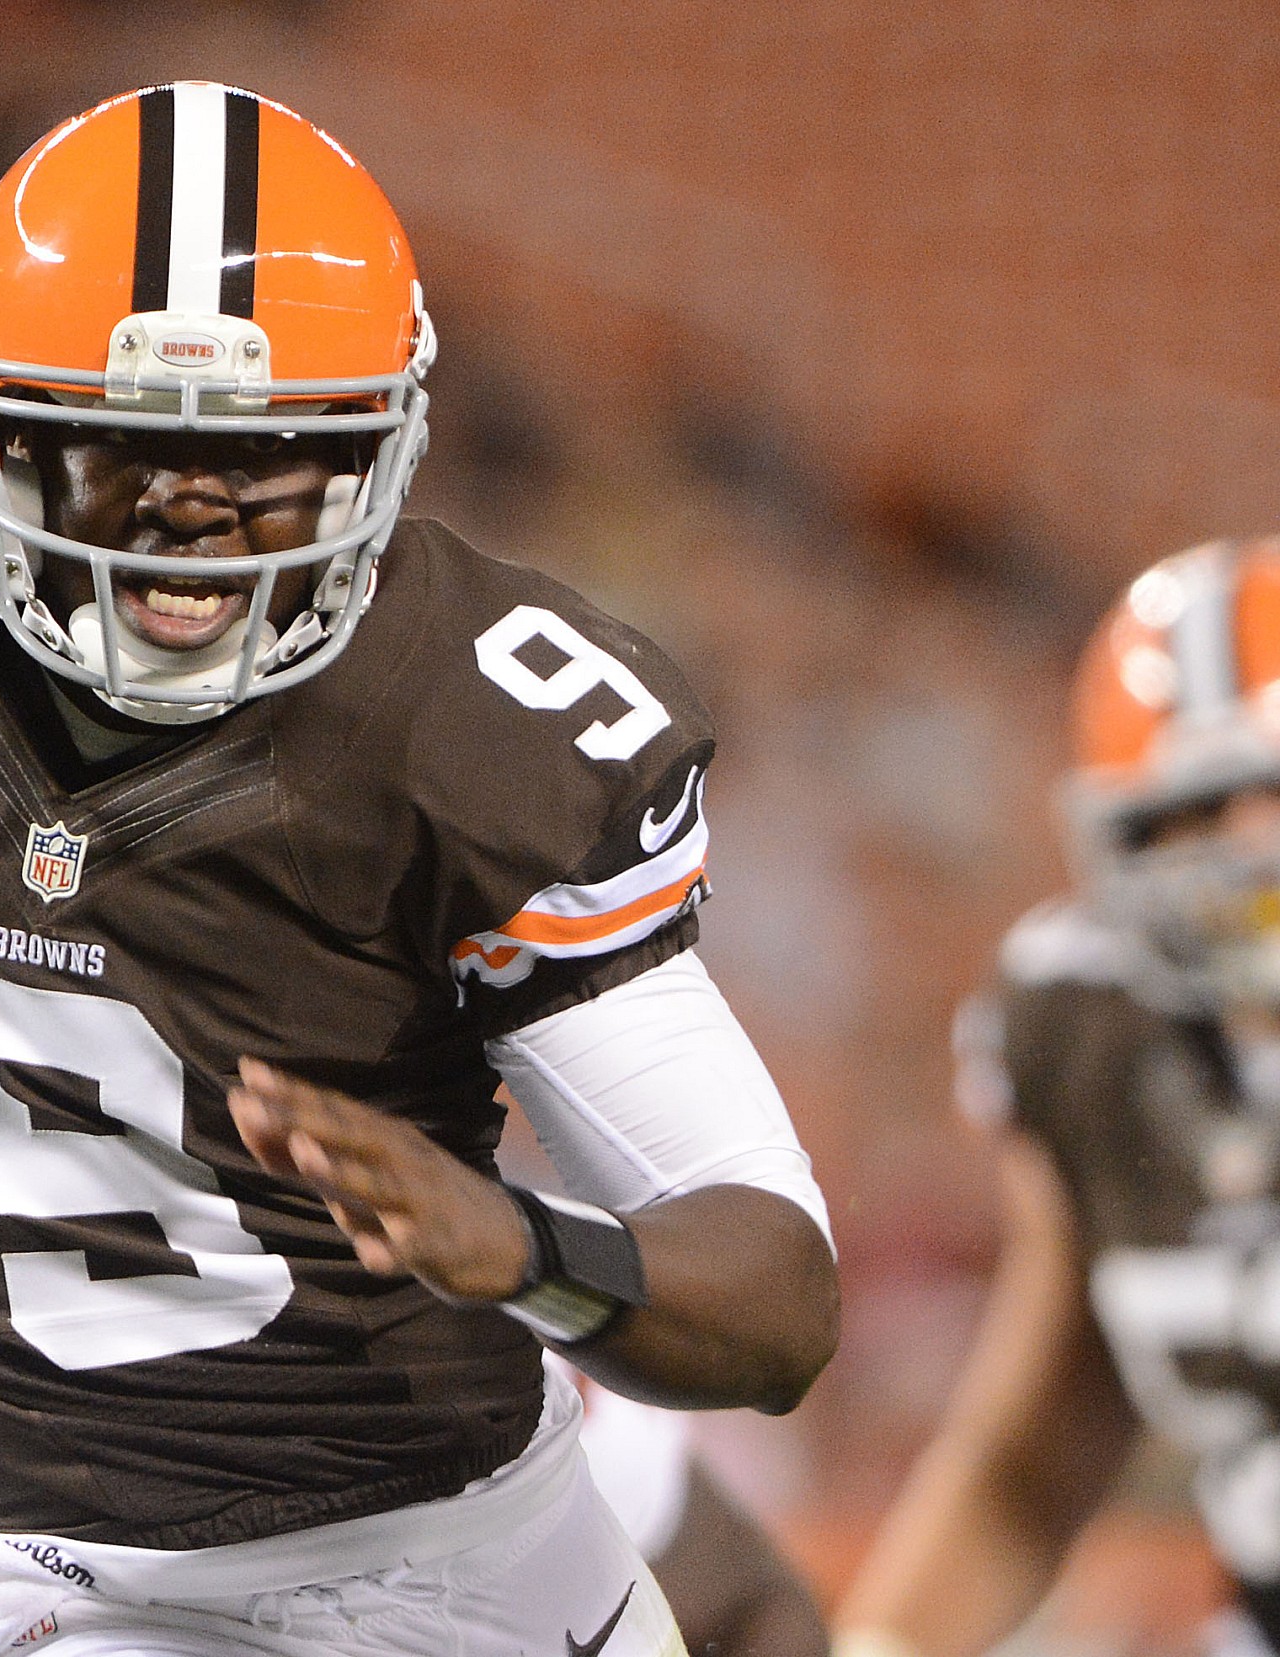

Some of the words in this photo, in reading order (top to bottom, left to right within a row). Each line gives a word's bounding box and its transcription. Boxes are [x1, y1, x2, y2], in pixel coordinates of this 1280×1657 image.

[162, 341, 215, 359] BROWNS
[476, 604, 672, 761] 9
[31, 854, 70, 888] NFL
